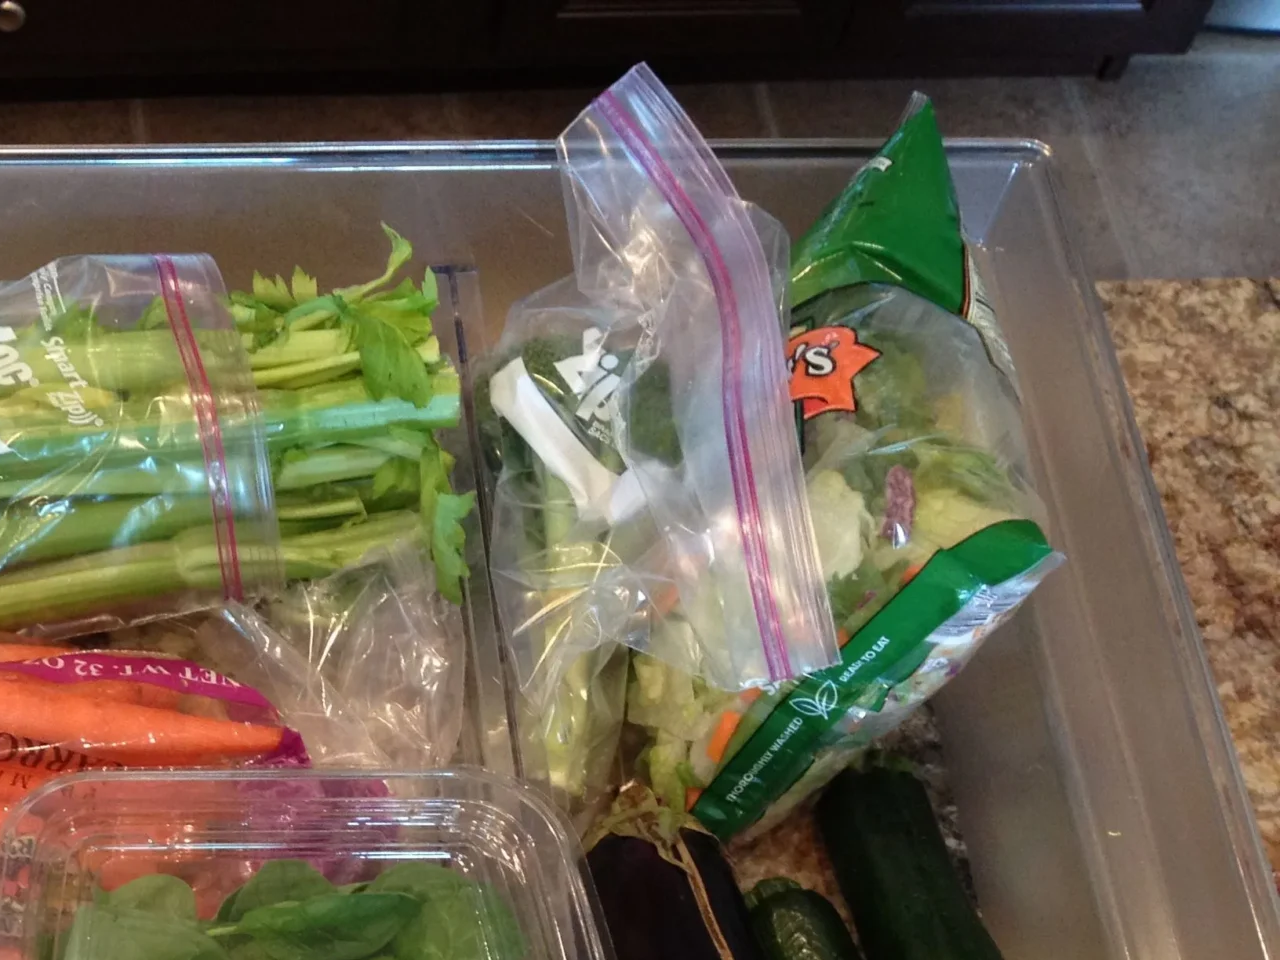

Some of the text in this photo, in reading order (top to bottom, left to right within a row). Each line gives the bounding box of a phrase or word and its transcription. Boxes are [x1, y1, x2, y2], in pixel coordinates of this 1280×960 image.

[41, 336, 89, 388] Smart
[73, 659, 104, 677] 32
[112, 664, 171, 677] WT.
[179, 666, 242, 688] NET
[770, 717, 804, 753] WASHED
[861, 650, 876, 665] TO
[875, 635, 891, 653] EAT
